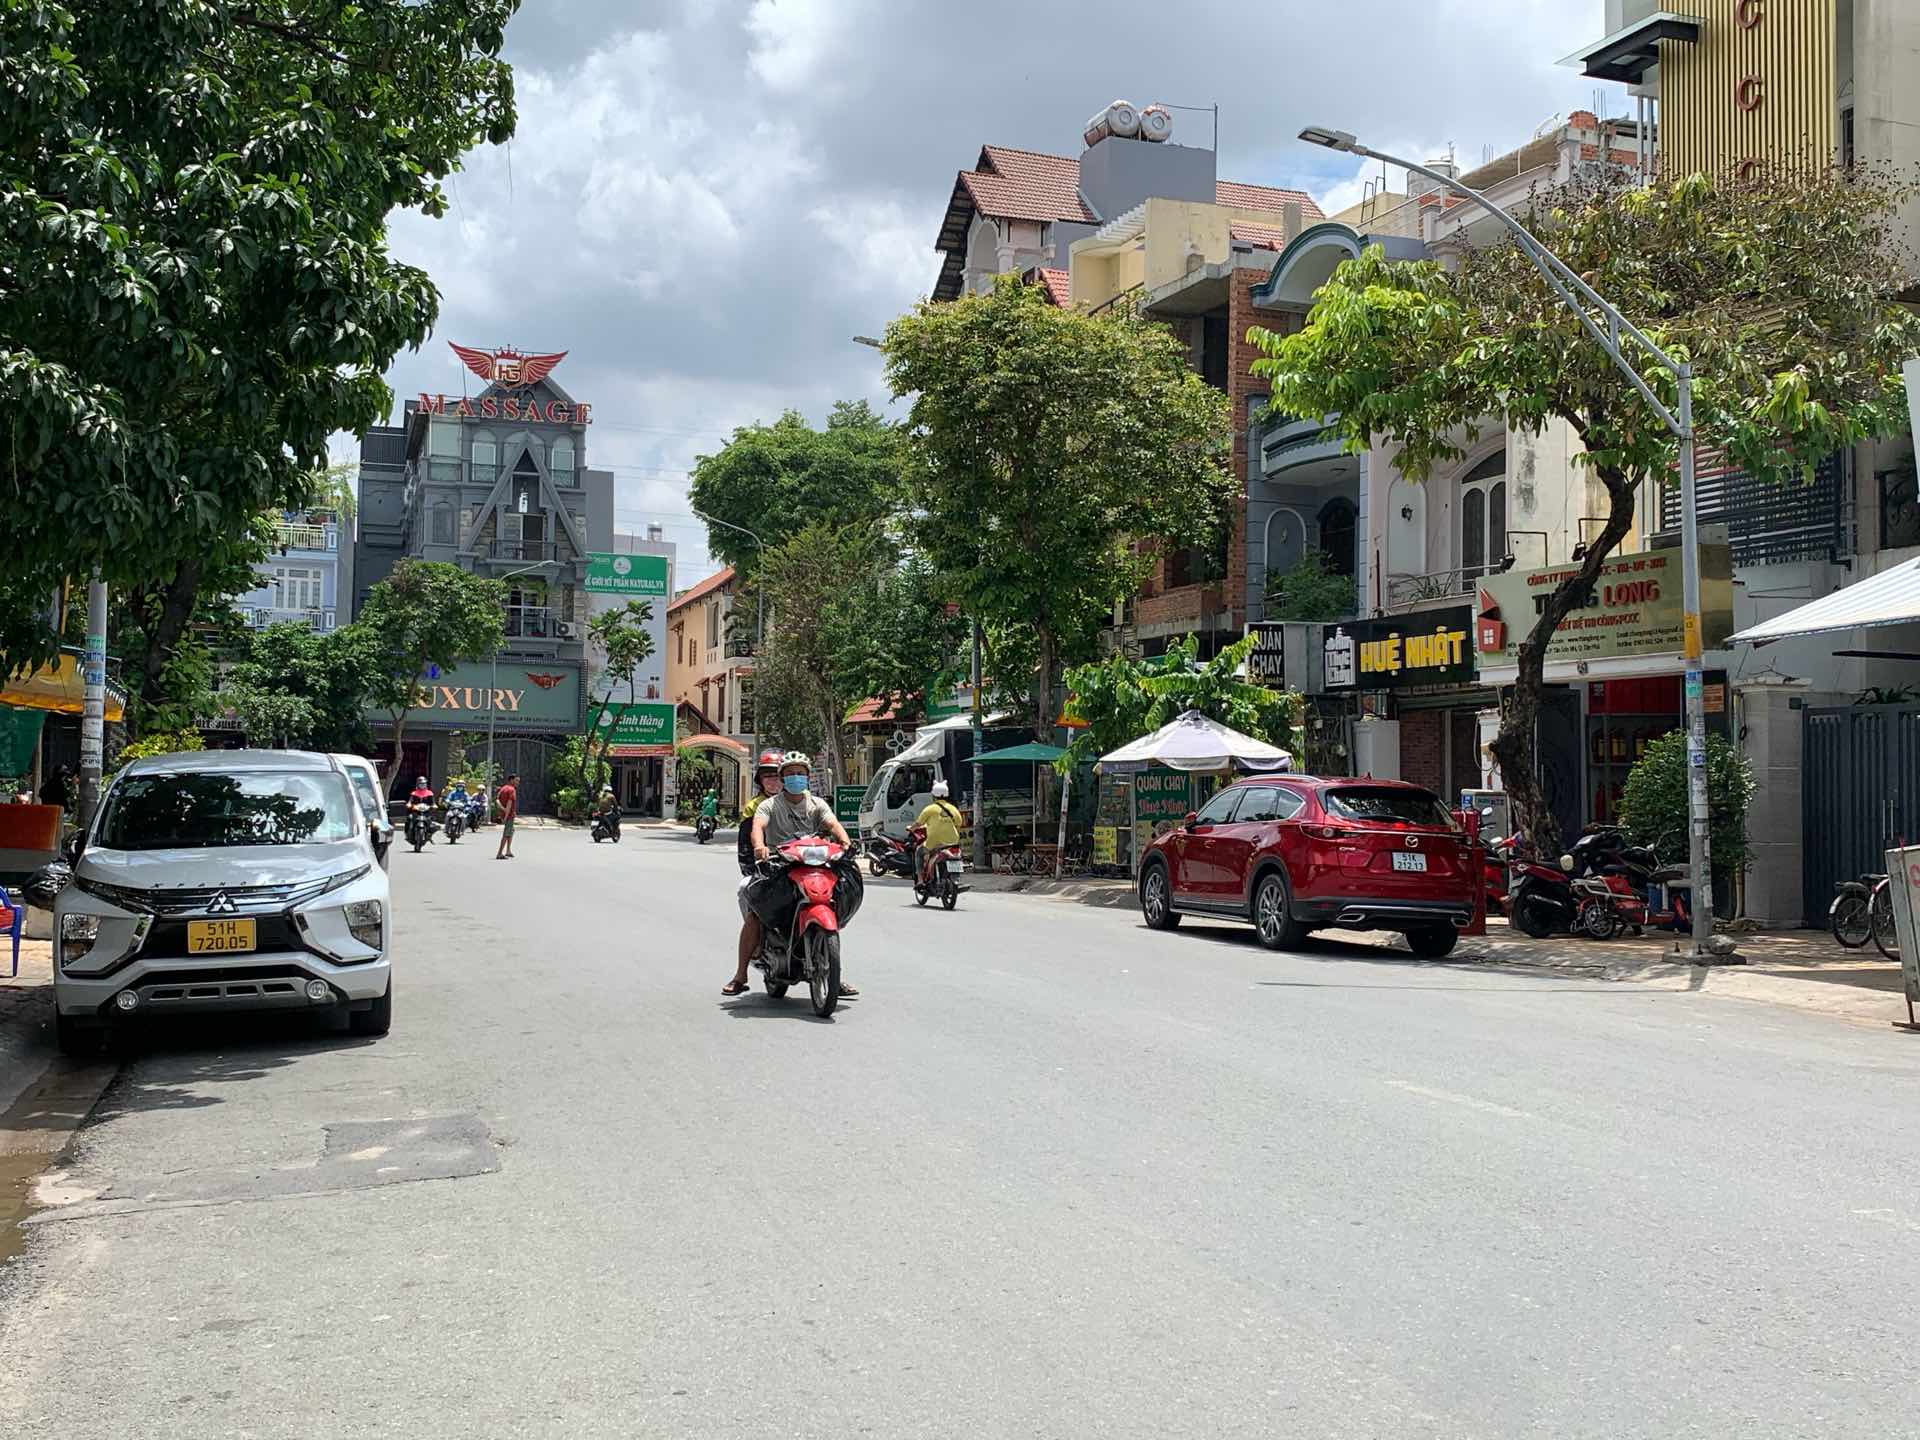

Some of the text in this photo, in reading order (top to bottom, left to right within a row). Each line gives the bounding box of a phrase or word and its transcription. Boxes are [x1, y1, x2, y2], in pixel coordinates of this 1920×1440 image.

[418, 393, 592, 425] MASSAGE
[1604, 579, 1659, 608] LONG
[1253, 626, 1282, 651] UÁN
[1360, 625, 1467, 676] HUỆ NHẬT
[1252, 654, 1282, 675] CHAY
[408, 685, 525, 712] UXURY
[207, 922, 236, 936] 51H
[196, 936, 248, 951] 720.05
